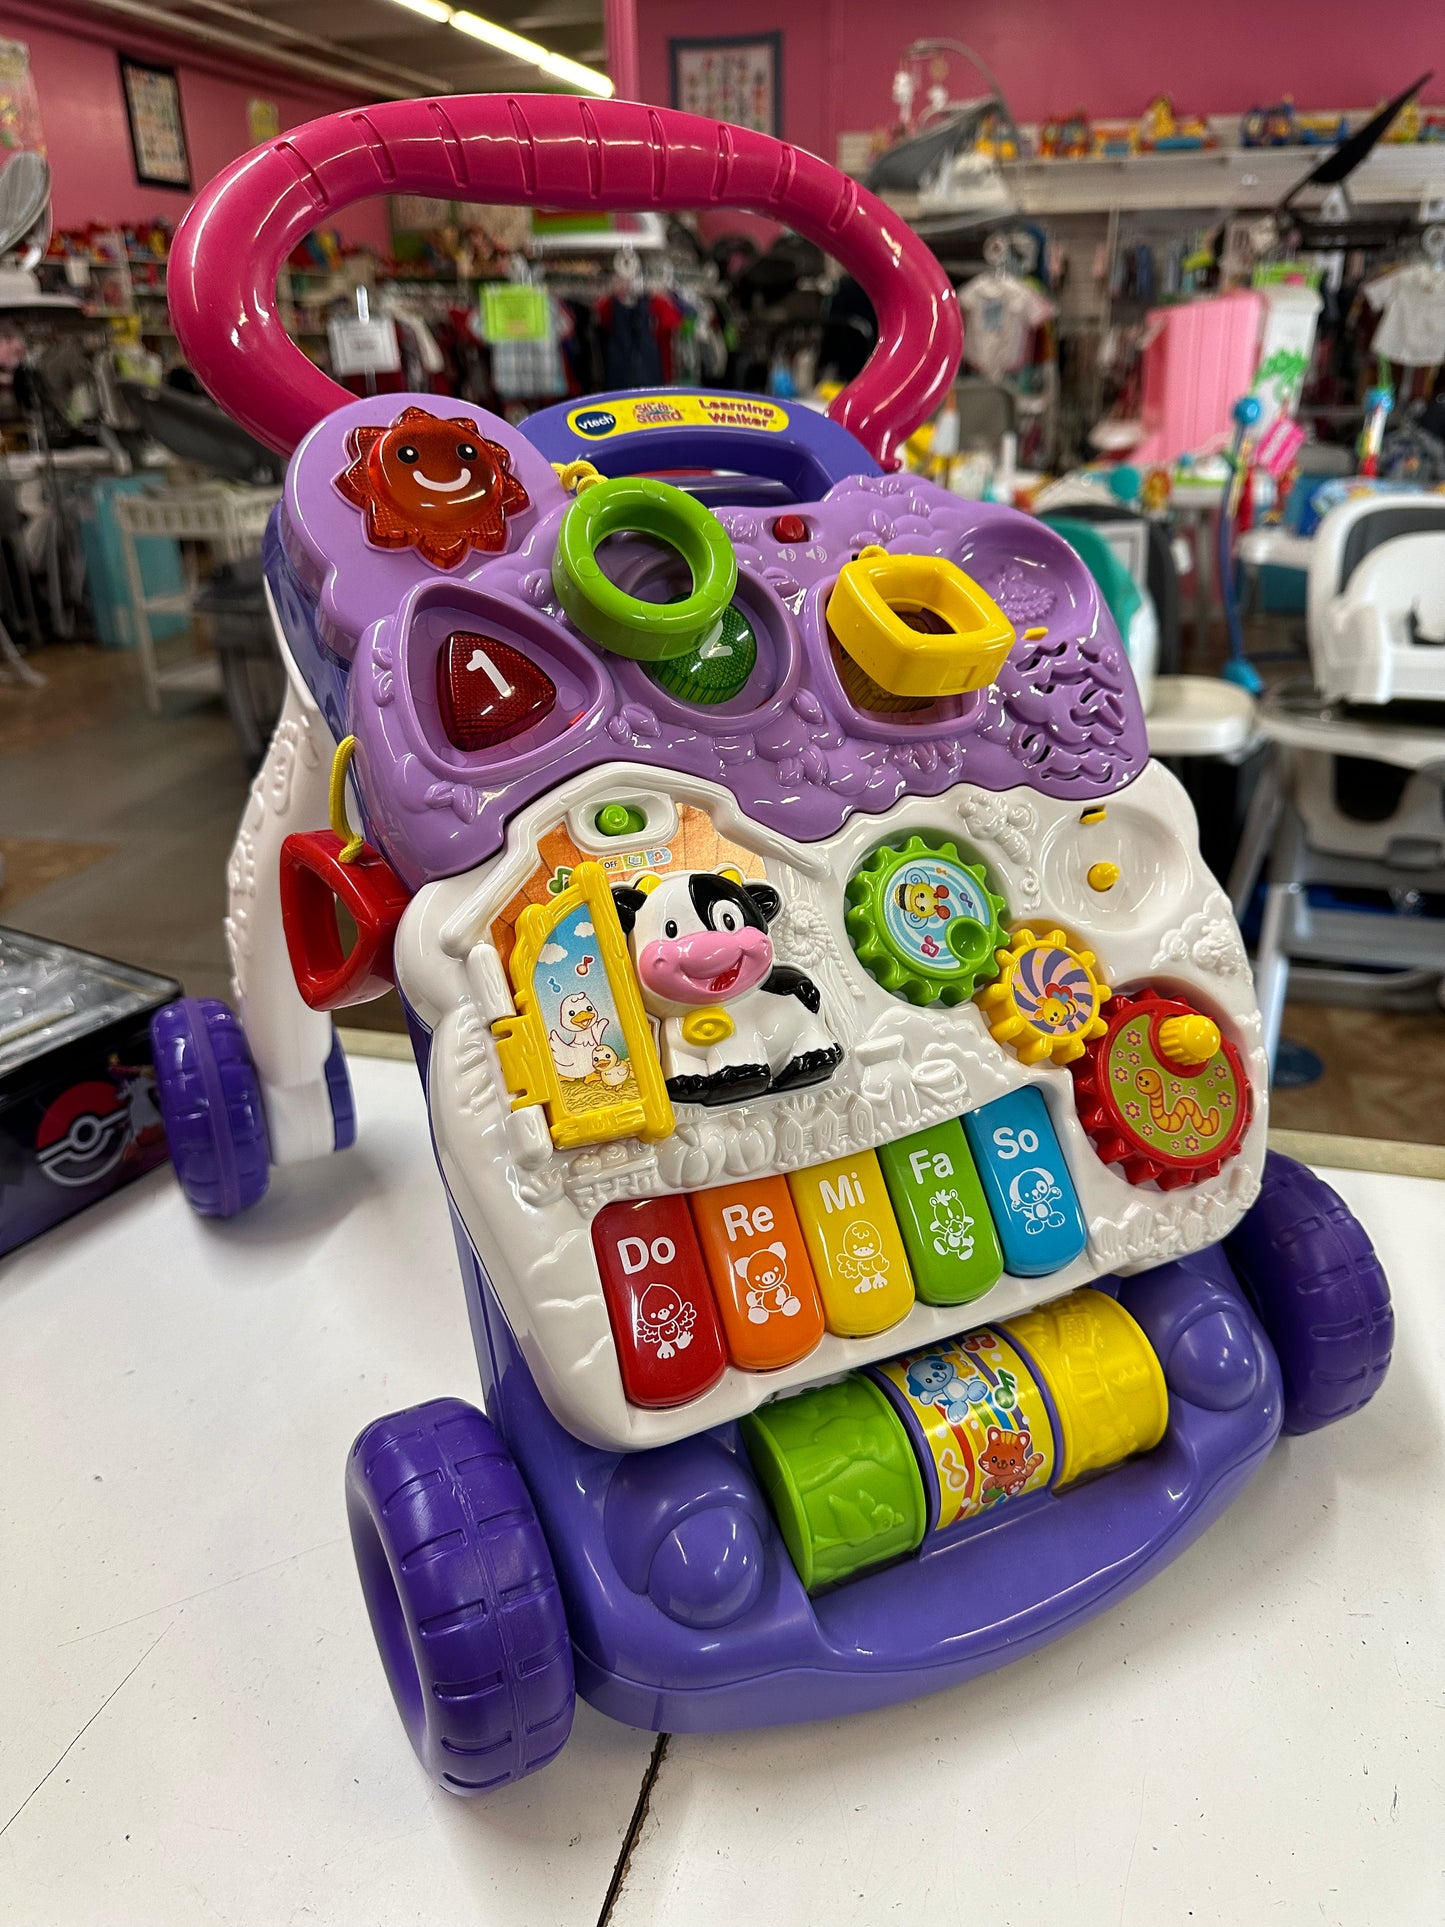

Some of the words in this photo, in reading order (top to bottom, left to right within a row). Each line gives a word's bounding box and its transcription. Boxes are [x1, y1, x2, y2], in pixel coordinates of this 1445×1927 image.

[698, 398, 775, 418] Learning
[707, 412, 768, 428] Walker
[466, 649, 512, 698] 1
[604, 860, 618, 869] OFF
[617, 1236, 676, 1275] Do
[722, 1204, 775, 1242] Re
[818, 1172, 866, 1214] Mi
[908, 1149, 955, 1185] Fa
[993, 1127, 1040, 1160] So
